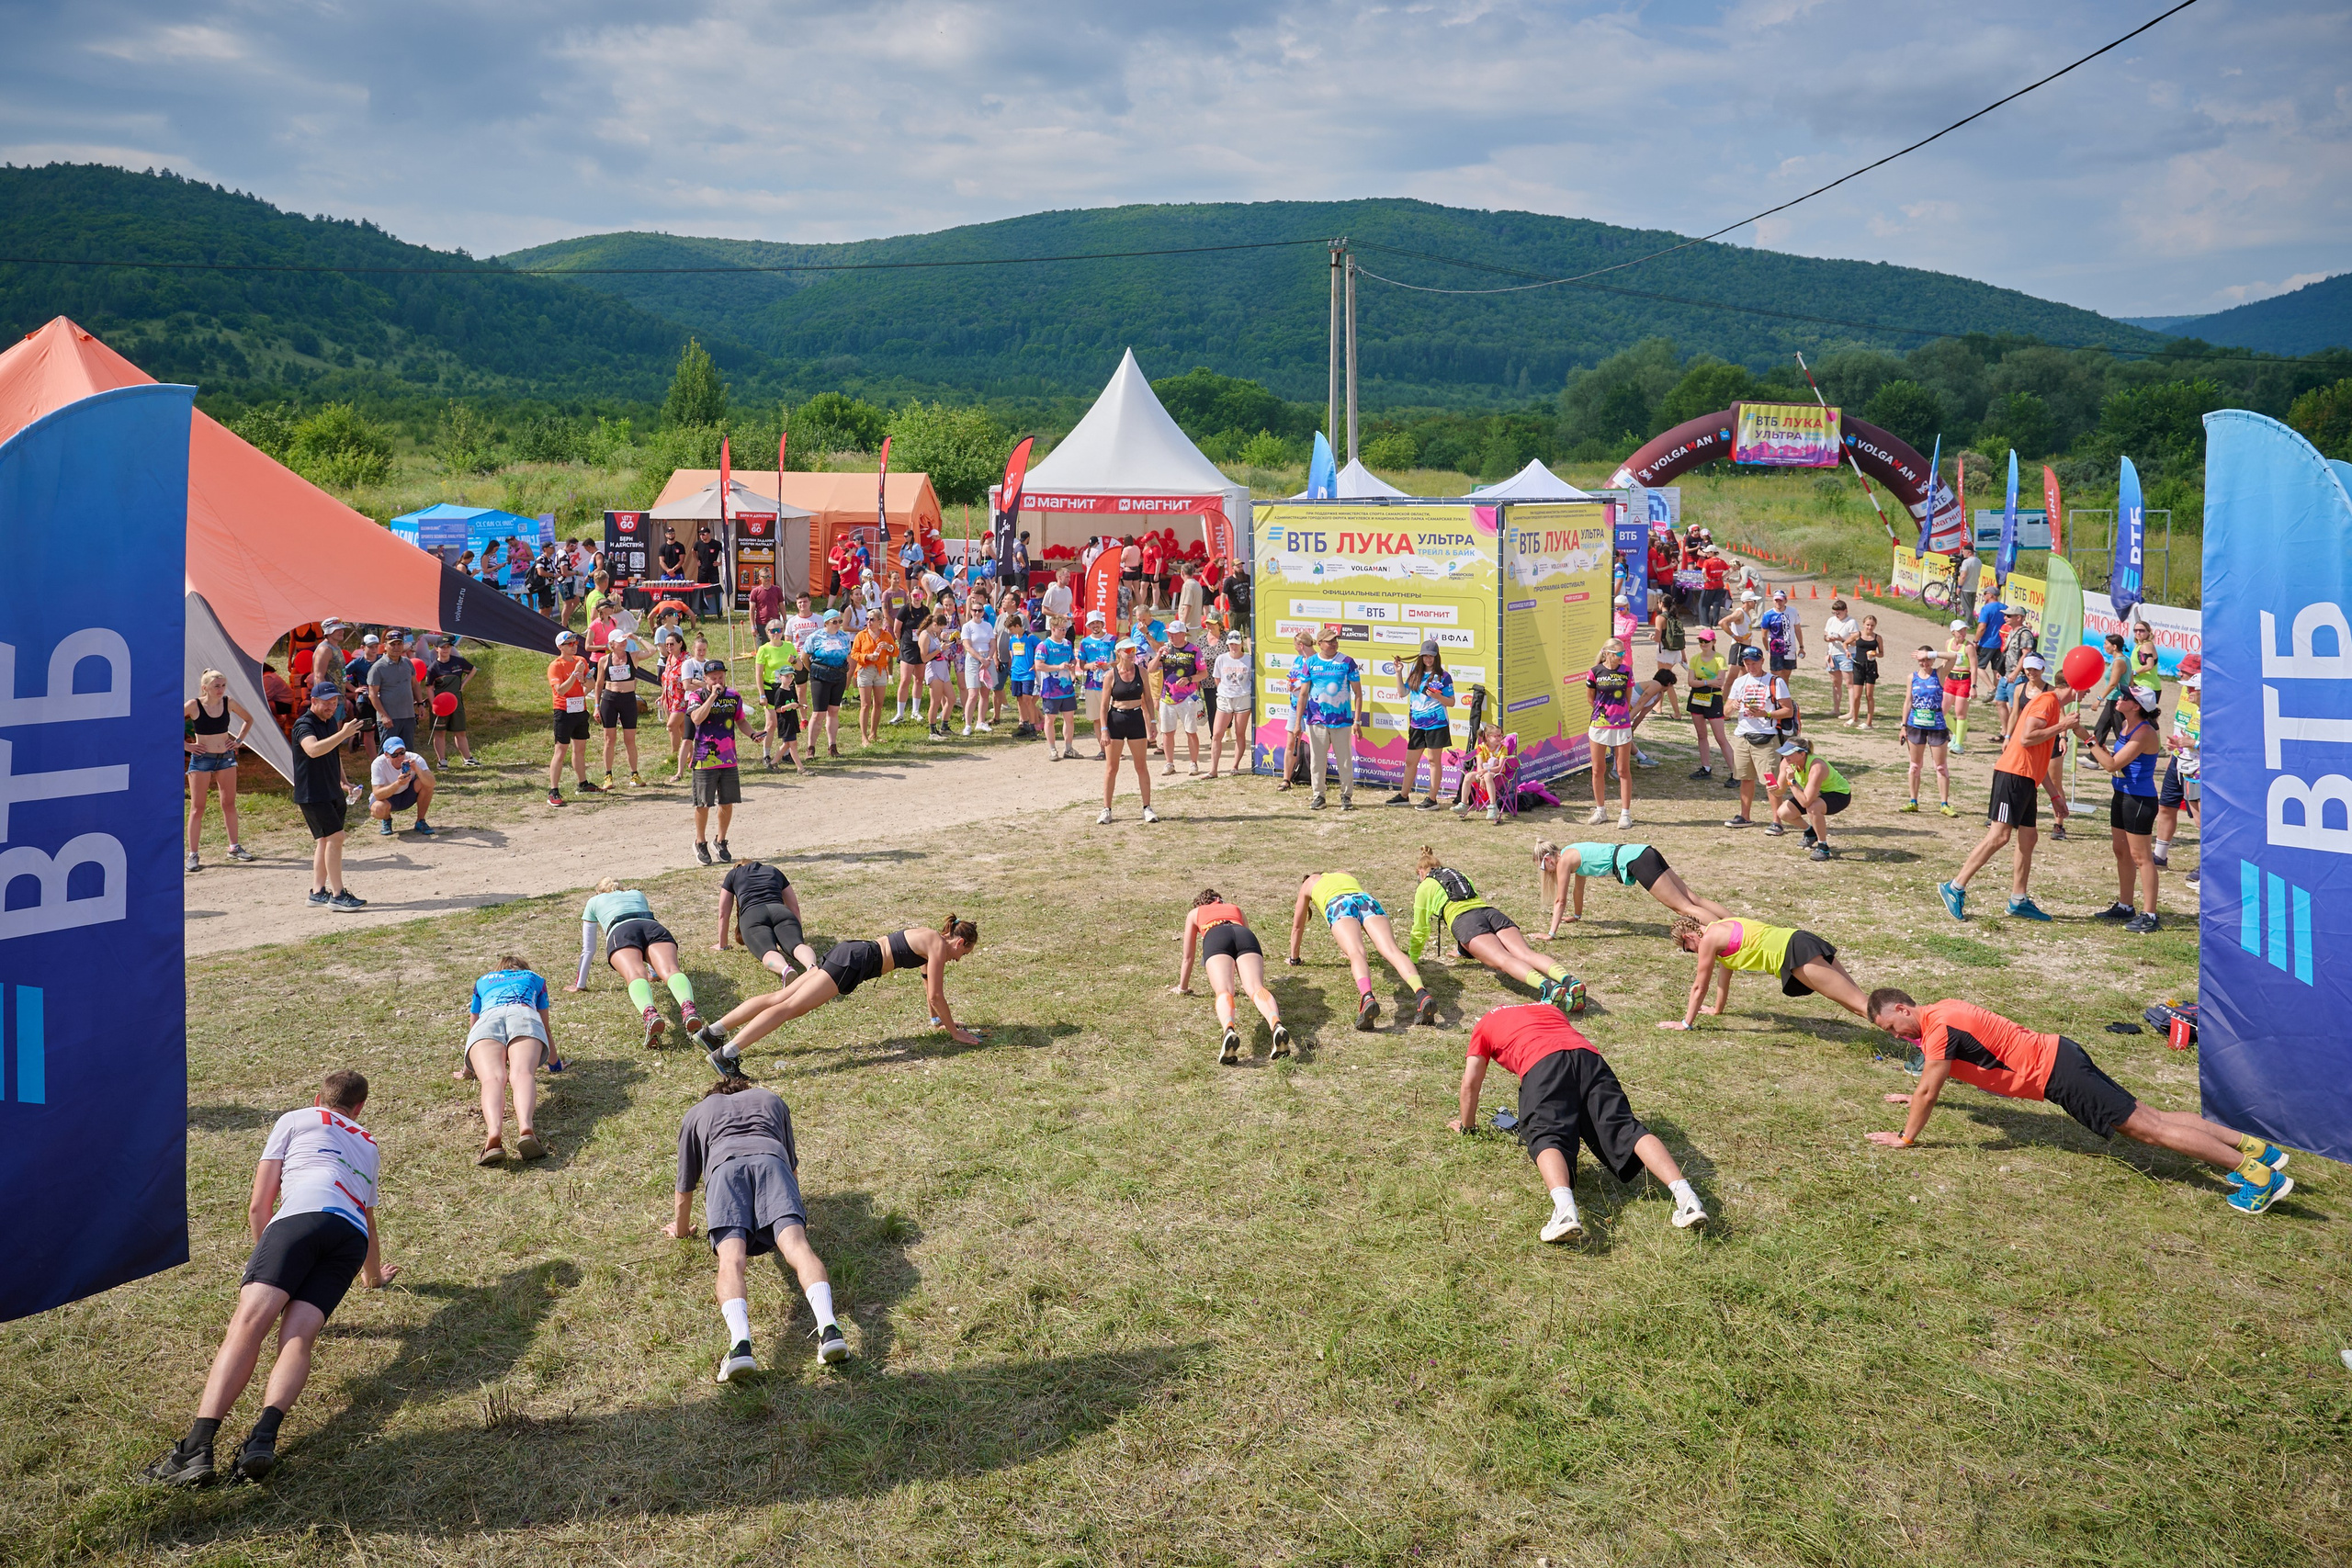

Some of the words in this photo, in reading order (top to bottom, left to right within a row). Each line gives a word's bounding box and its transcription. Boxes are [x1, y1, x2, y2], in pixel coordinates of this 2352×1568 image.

[1756, 416, 1778, 426] ВТБ
[1782, 417, 1823, 428] ЛУКА
[1756, 430, 1803, 440] УЛЬТРА
[1037, 497, 1096, 510] магнит
[1132, 499, 1192, 511] магнит
[620, 521, 634, 529] GO
[1581, 528, 1604, 539] УЛЬТРА
[1619, 531, 1637, 541] ВТБ
[1287, 532, 1328, 553] ВТБ
[1336, 533, 1415, 555] ЛУКА
[1418, 534, 1475, 546] УЛЬТРА
[1520, 531, 1540, 555] ВТБ
[1544, 529, 1580, 553] ЛУКА
[1453, 548, 1476, 557] БАЙК
[1907, 556, 1920, 569] ЛУКА
[1533, 584, 1560, 592] ПРОГРАММА
[1560, 581, 1586, 589] ФЕСТИВАЛЯ
[1322, 589, 1380, 597] ОФИЦИАЛЬНЫЕ
[2014, 586, 2027, 602] ВТБ
[2030, 590, 2045, 606] ЛУК
[1366, 607, 1385, 618] ВТБ
[794, 622, 819, 631] SAMARA
[2260, 602, 2352, 853] ВТБ
[1377, 758, 1407, 767] ОБЛАСТИ
[1353, 767, 1405, 778] #ЛУКАУЛЬТРАБА
[0, 626, 131, 941] ВТБ
